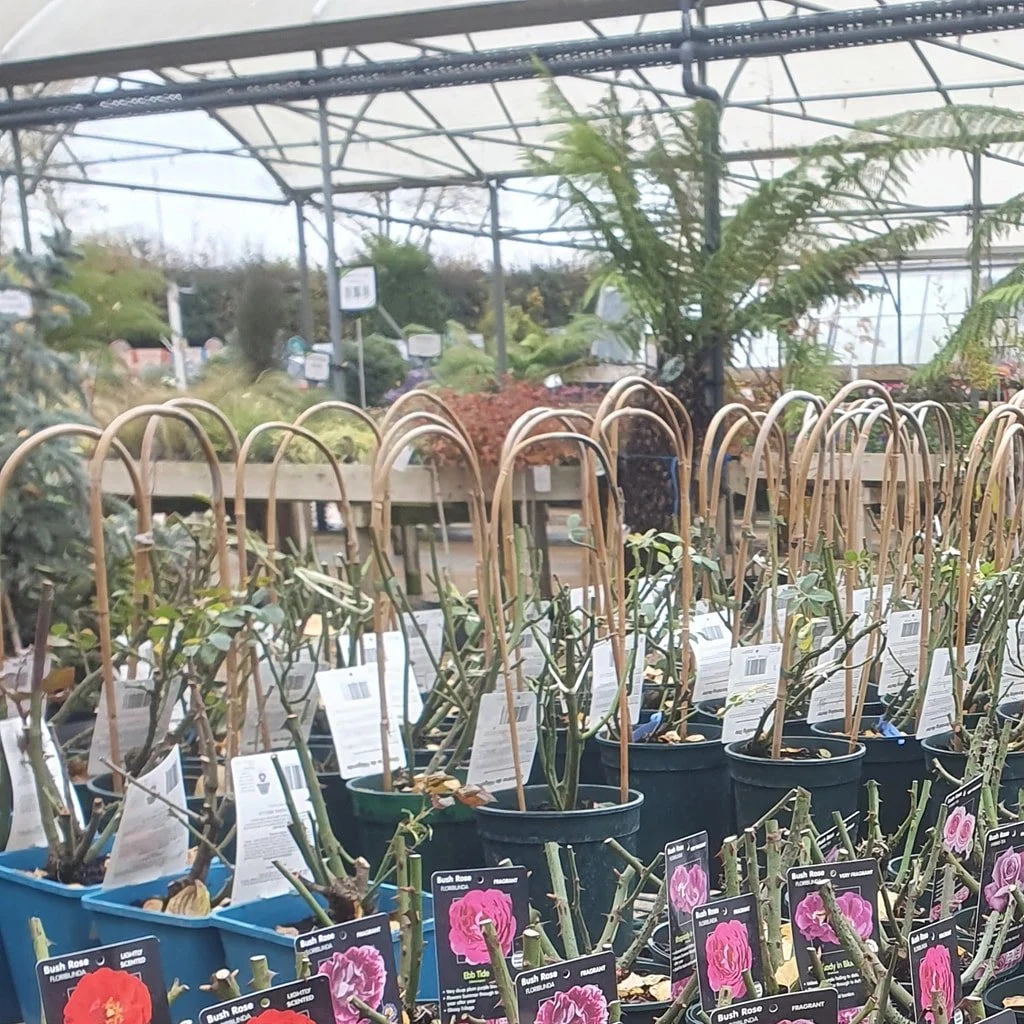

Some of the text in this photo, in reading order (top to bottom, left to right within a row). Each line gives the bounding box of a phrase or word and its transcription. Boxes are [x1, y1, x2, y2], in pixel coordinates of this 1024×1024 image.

[437, 876, 453, 884] Bush
[43, 957, 90, 975] Bush Rose
[521, 970, 558, 986] Bush Rose
[206, 1001, 254, 1024] Bush Rose
[718, 1005, 762, 1023] Bush Rose
[792, 1001, 825, 1012] FRAGRANT
